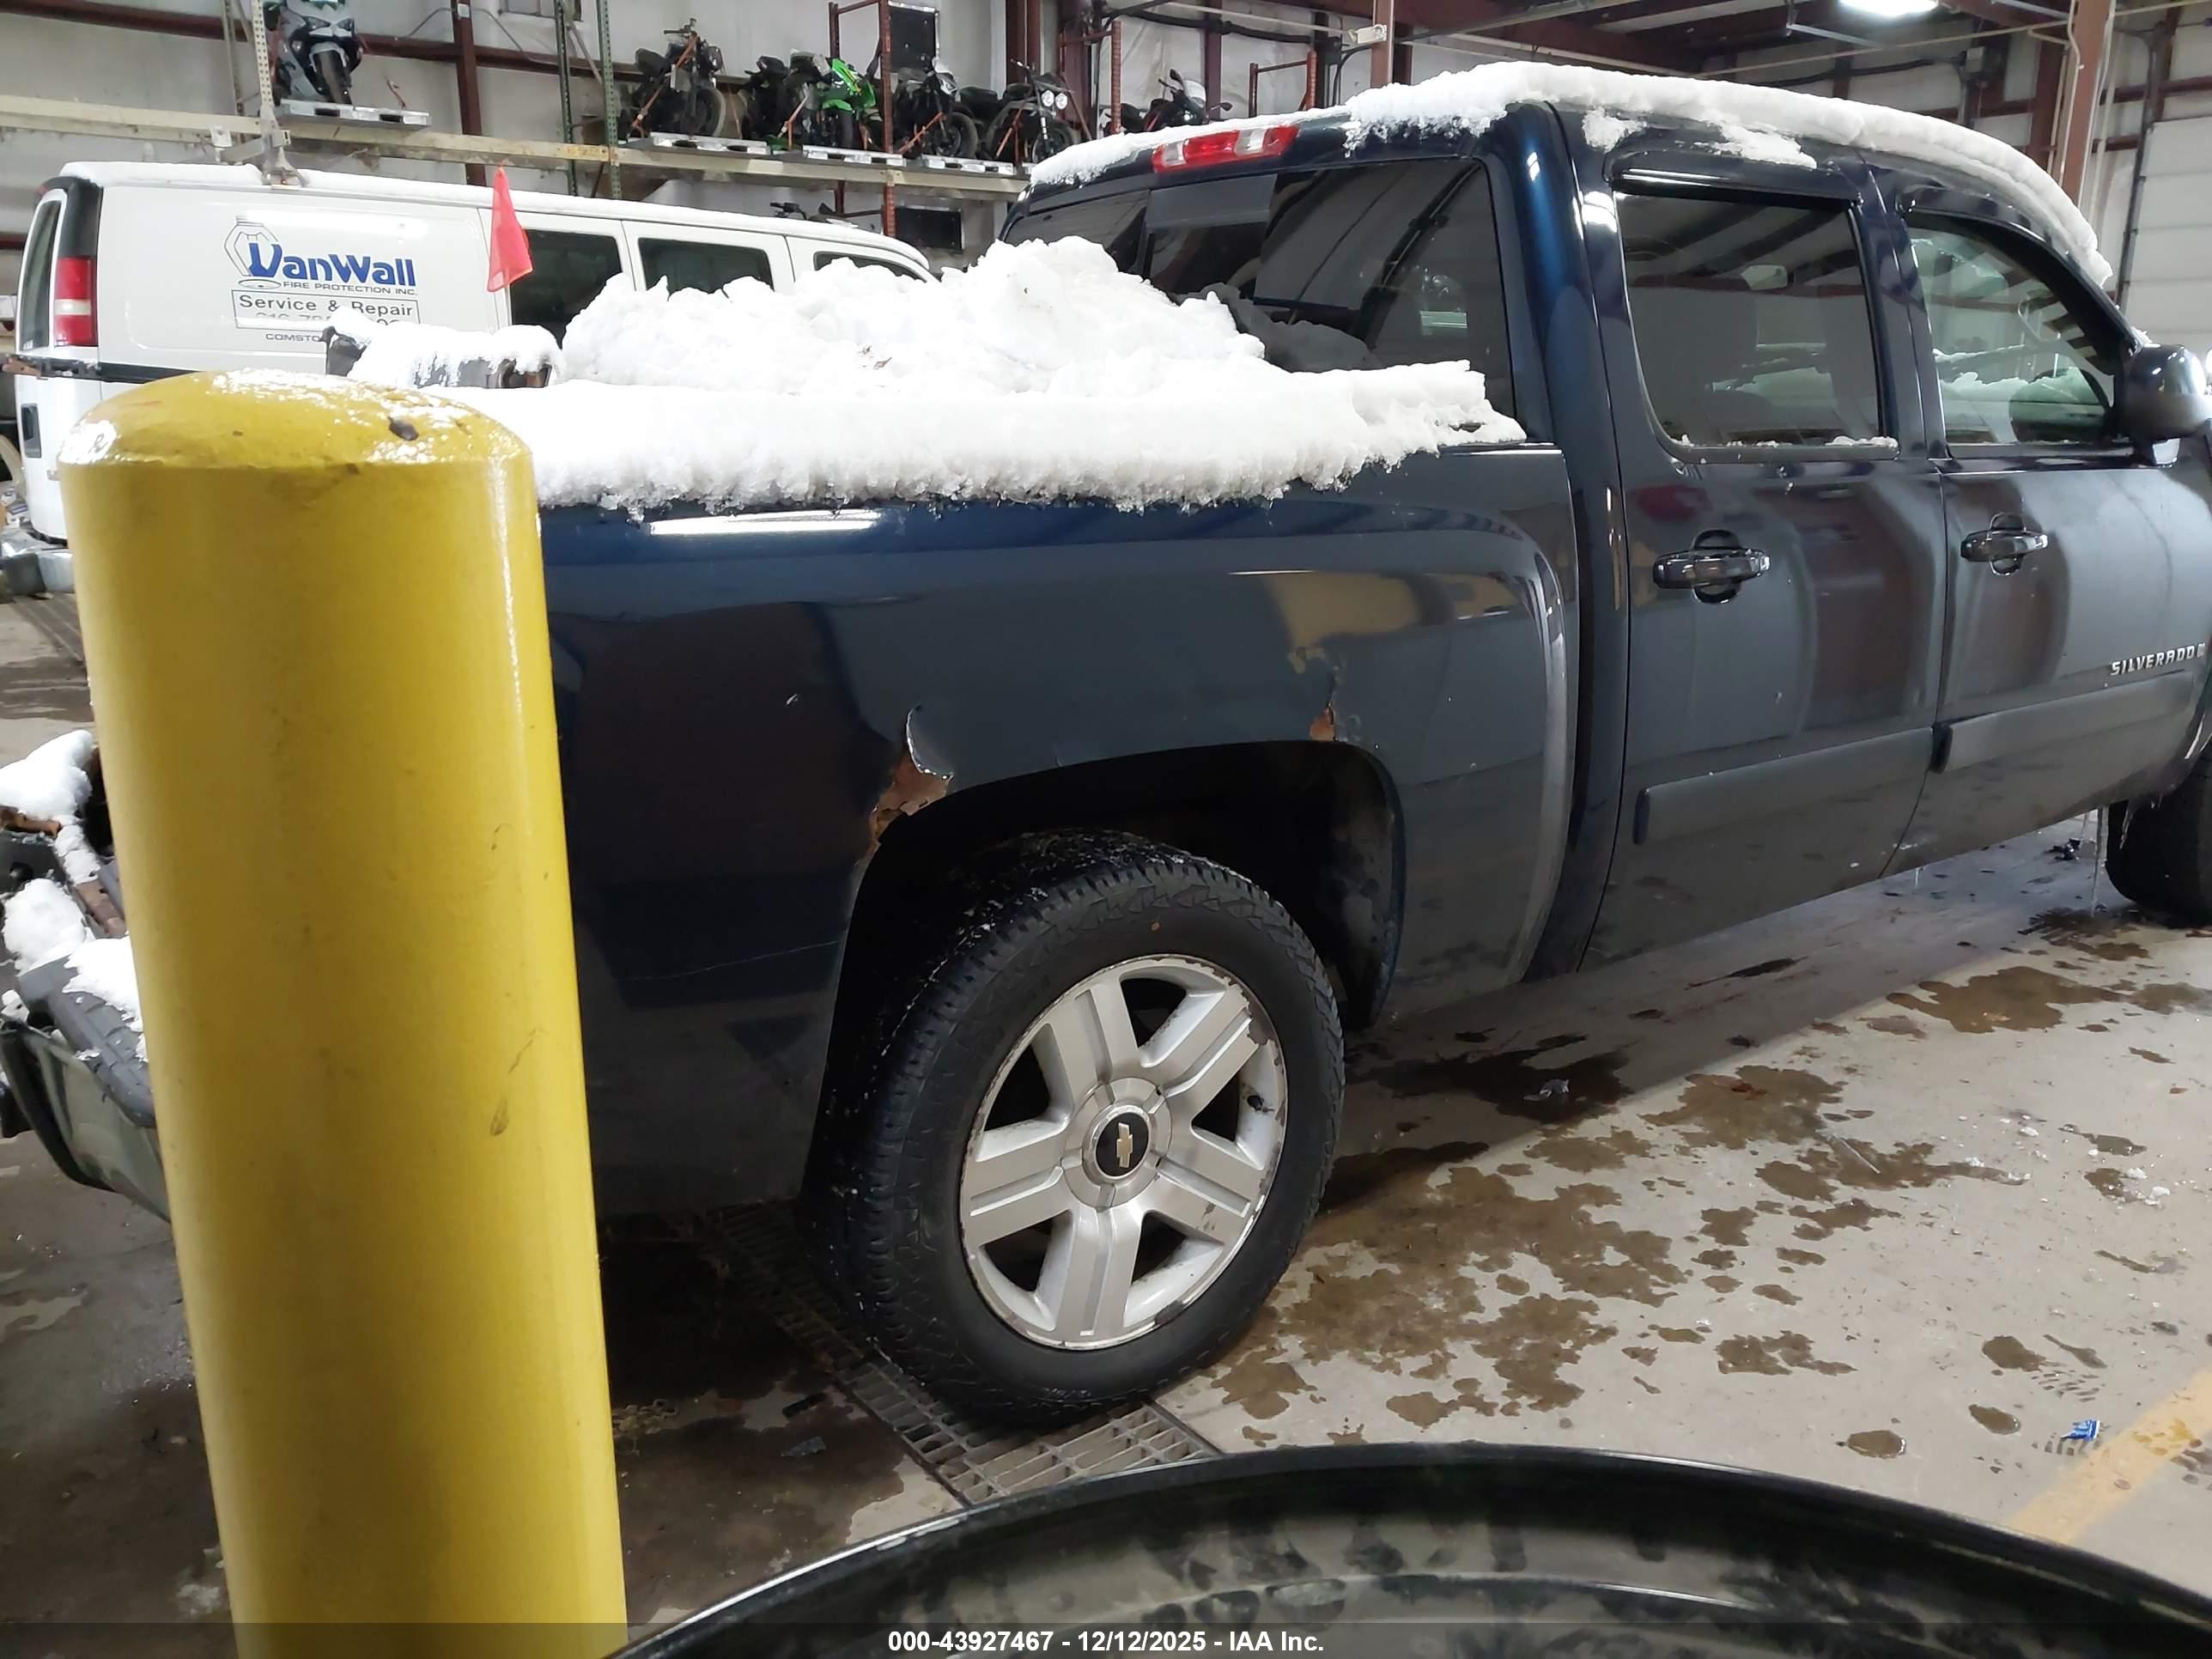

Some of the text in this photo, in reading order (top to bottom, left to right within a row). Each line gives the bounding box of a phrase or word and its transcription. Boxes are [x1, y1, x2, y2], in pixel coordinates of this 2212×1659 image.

[248, 242, 416, 287] VanWall
[283, 281, 418, 296] FIRE PROTECTION INC.
[239, 295, 317, 312] Service
[328, 300, 341, 313] &
[350, 301, 413, 318] Repair
[2110, 645, 2196, 676] SILVERADO
